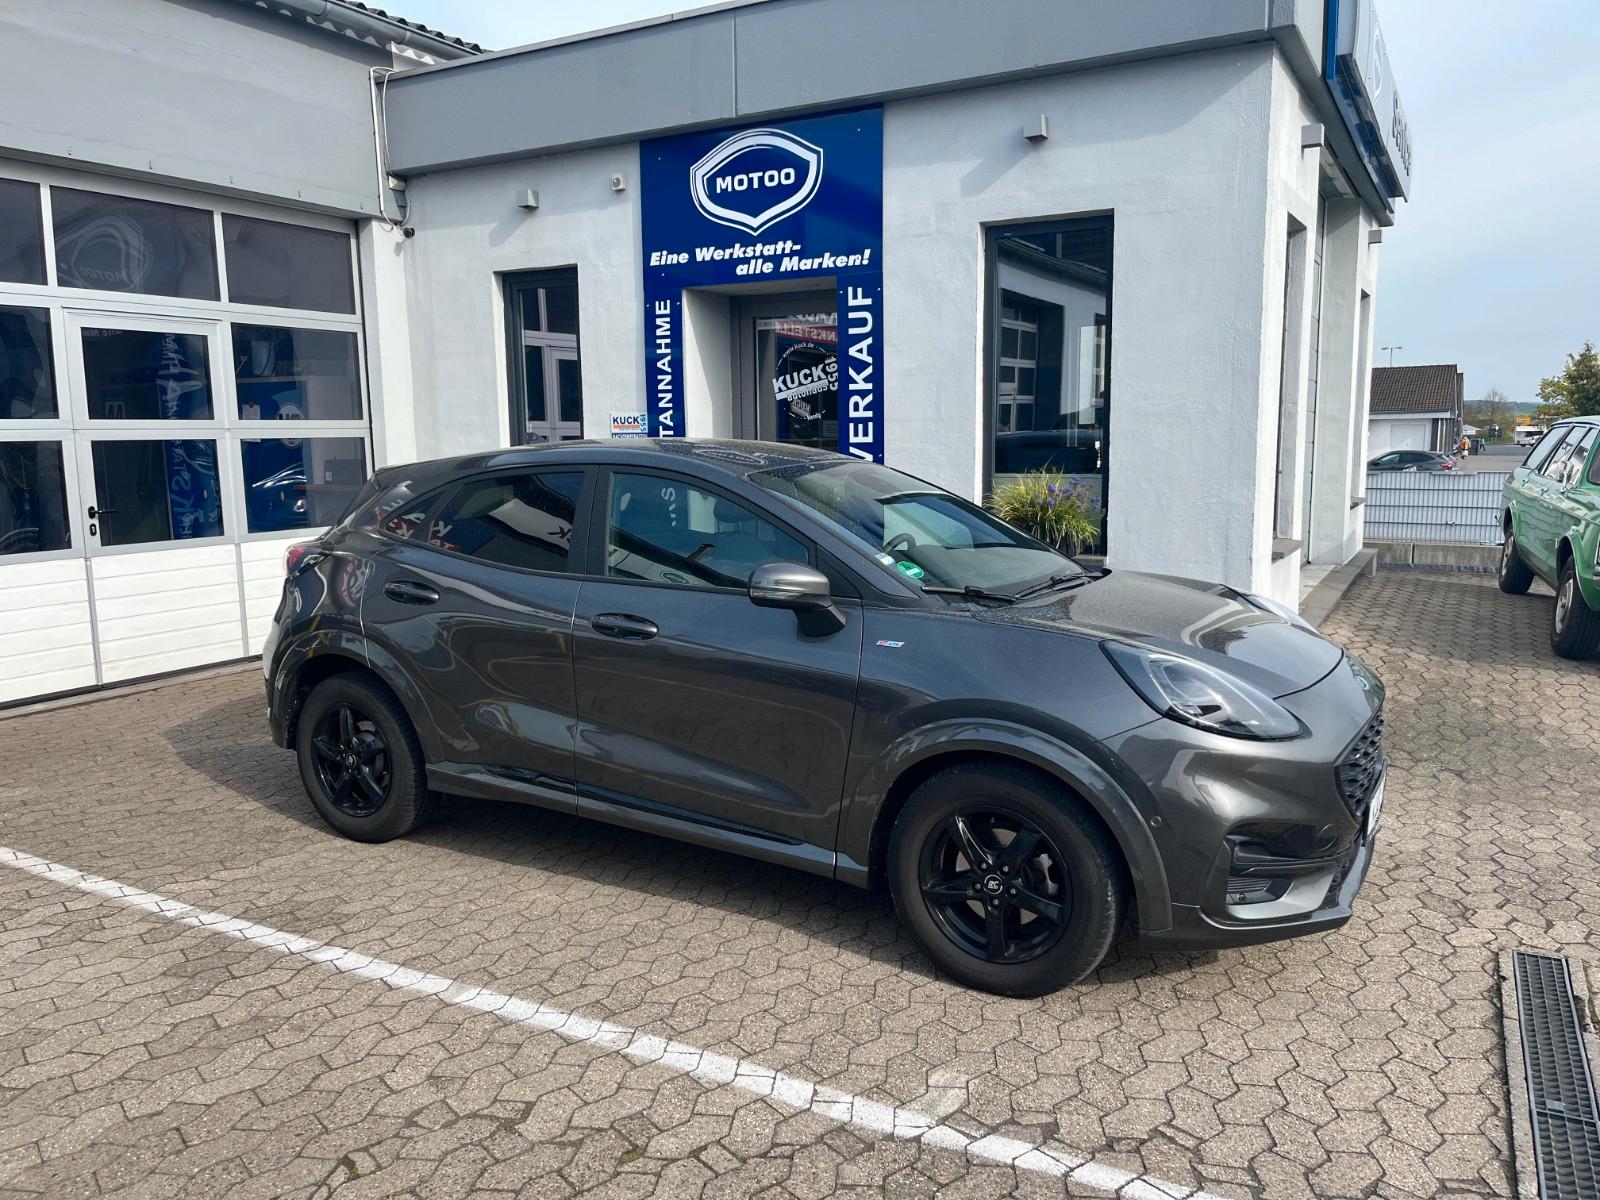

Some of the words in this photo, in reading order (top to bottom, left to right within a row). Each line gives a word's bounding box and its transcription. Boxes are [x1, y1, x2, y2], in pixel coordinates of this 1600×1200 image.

[716, 168, 796, 193] MOTOO
[650, 251, 689, 266] Eine
[695, 240, 801, 262] Werkstatt-
[736, 260, 774, 275] alle
[780, 249, 871, 273] Marken!
[772, 364, 827, 393] KUCK
[824, 356, 838, 391] 1955
[612, 416, 640, 425] KUCK
